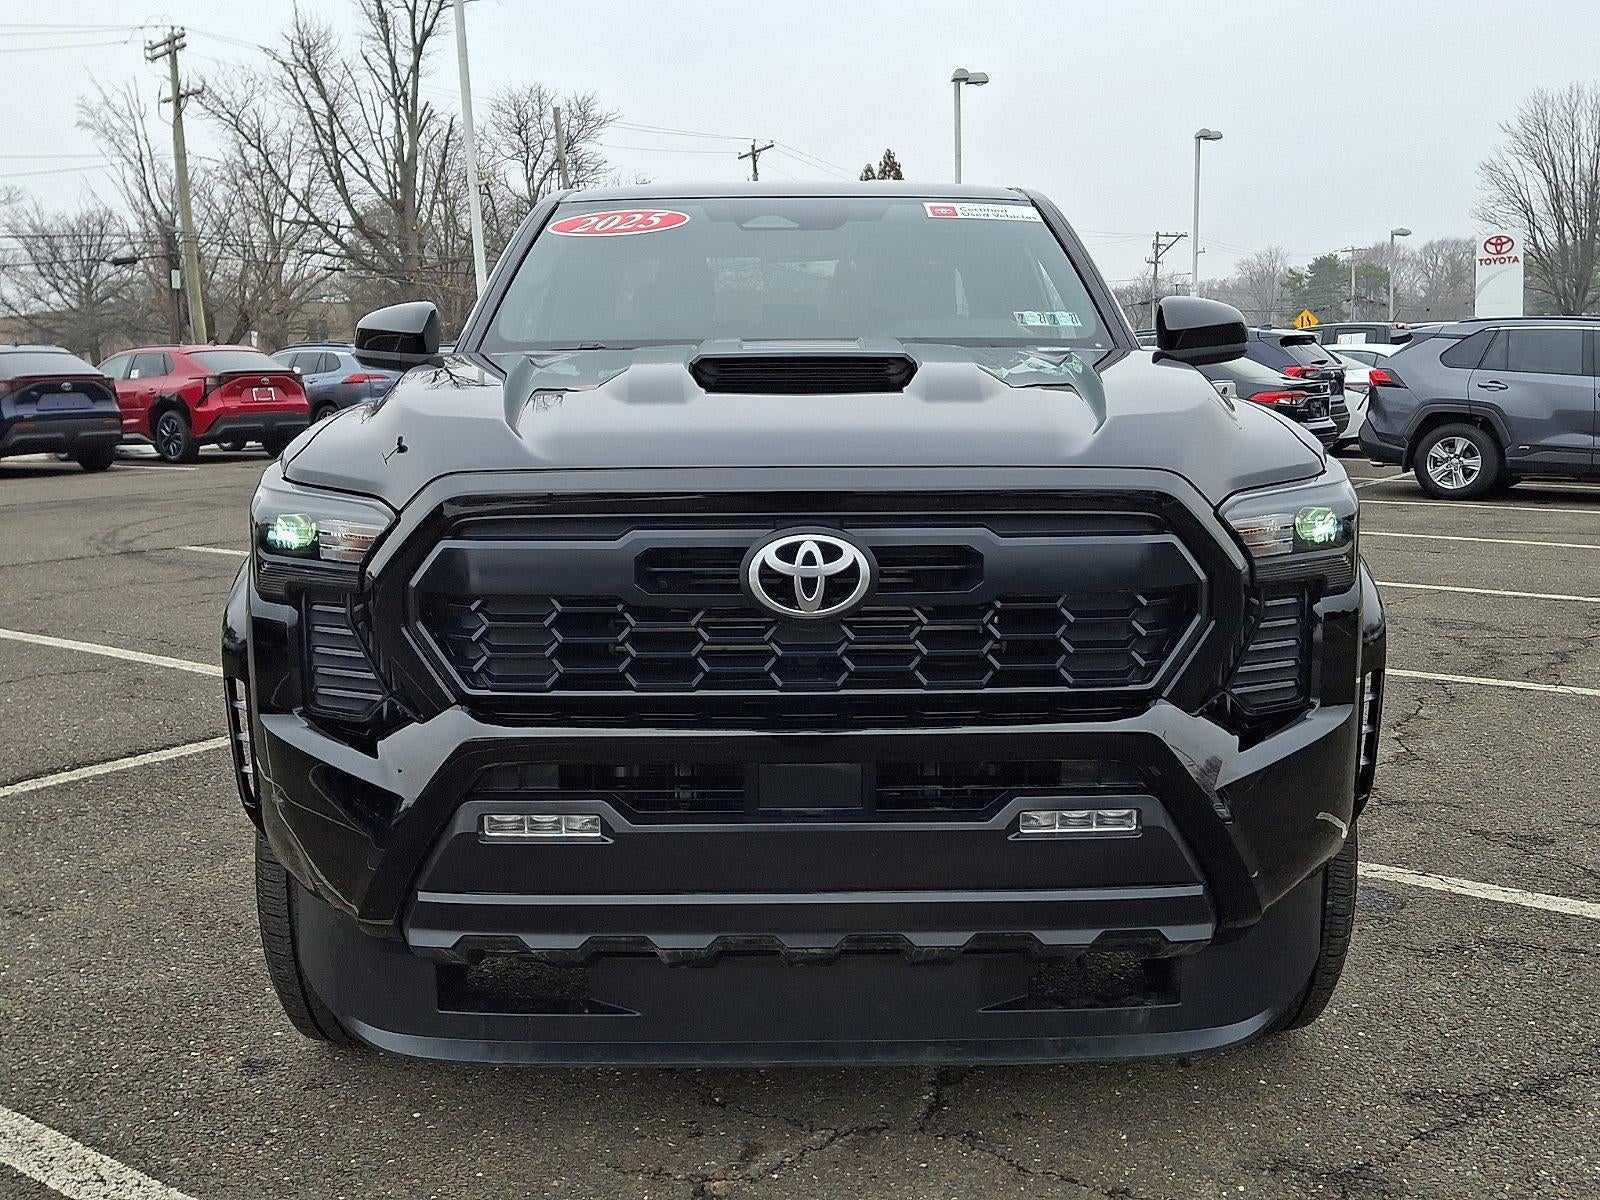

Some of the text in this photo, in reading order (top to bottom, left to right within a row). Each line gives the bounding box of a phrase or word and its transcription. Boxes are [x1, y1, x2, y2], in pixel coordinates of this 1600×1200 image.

[959, 206, 1008, 214] Certified
[568, 211, 670, 233] 2025
[1478, 256, 1519, 266] TOYOTA
